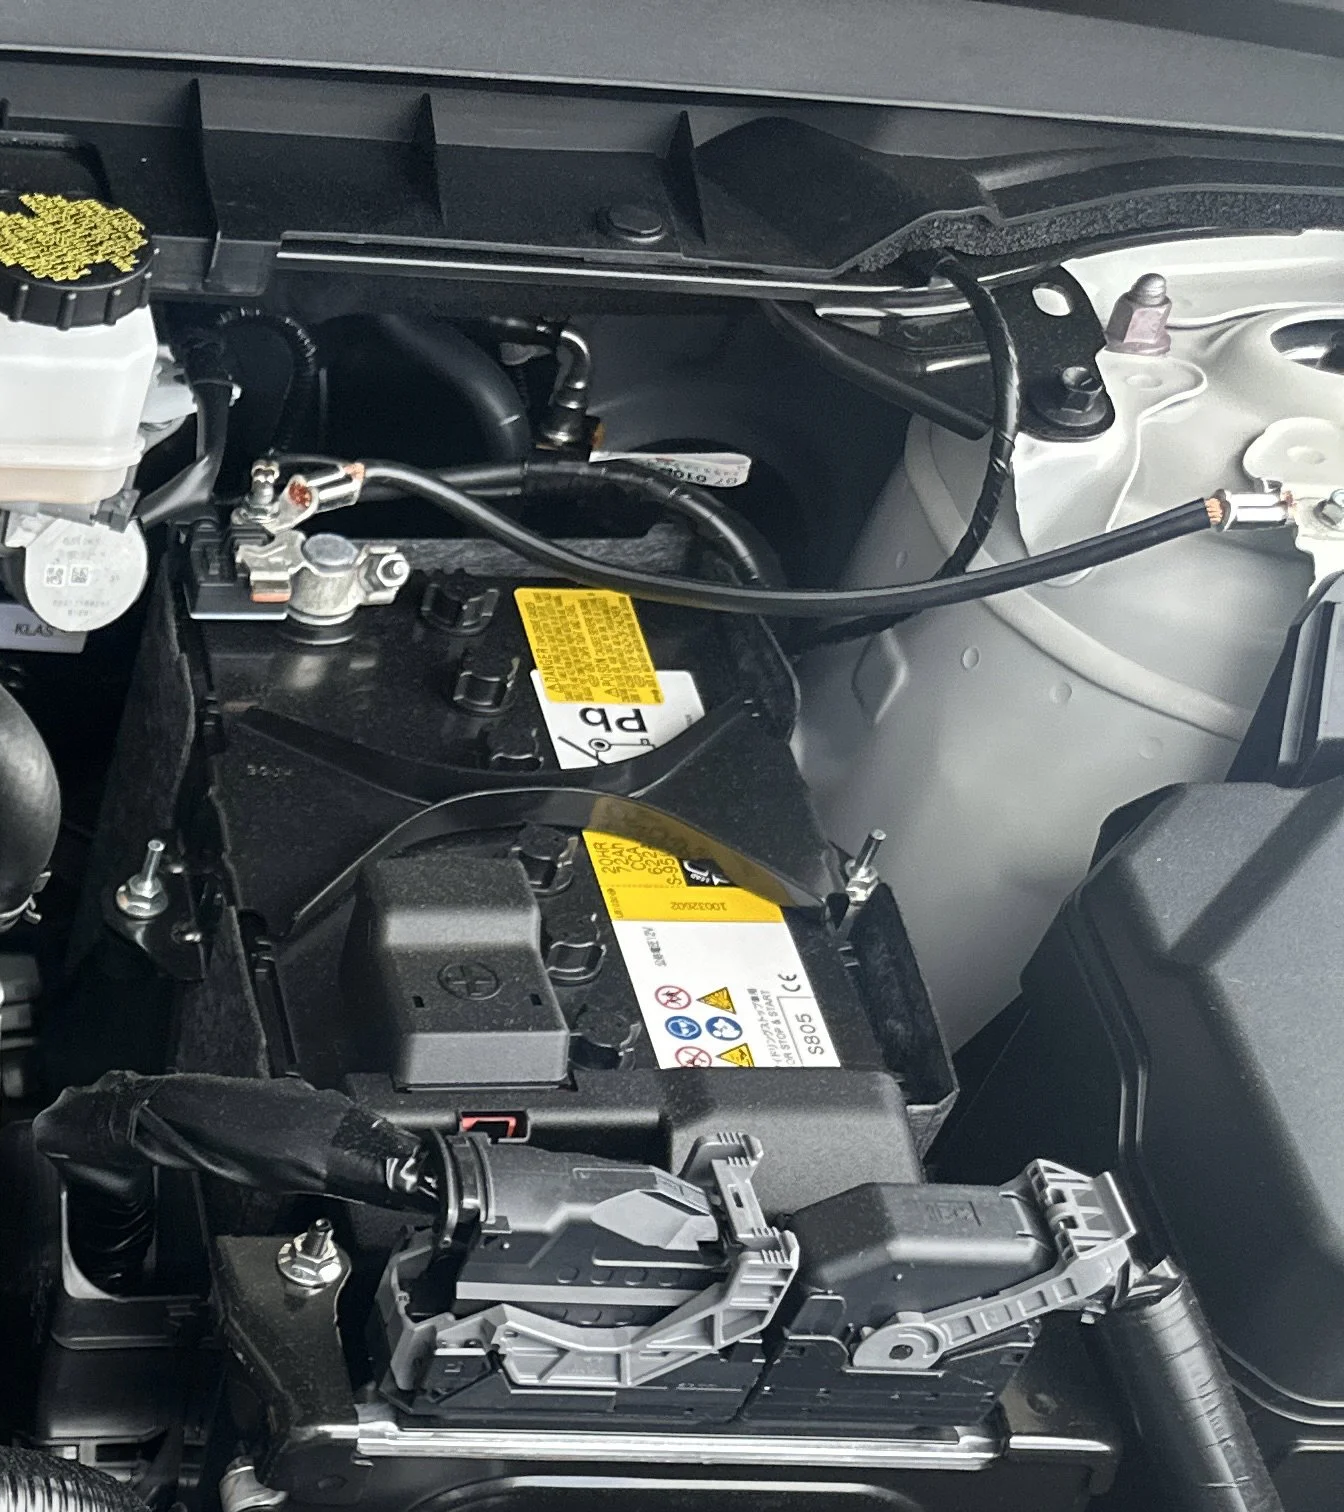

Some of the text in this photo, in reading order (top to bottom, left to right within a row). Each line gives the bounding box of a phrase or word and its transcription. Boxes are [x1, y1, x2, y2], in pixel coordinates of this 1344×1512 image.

[578, 707, 649, 733] Pb
[593, 841, 614, 874] 20HR
[626, 846, 646, 871] CCA
[795, 1013, 825, 1056] S805
